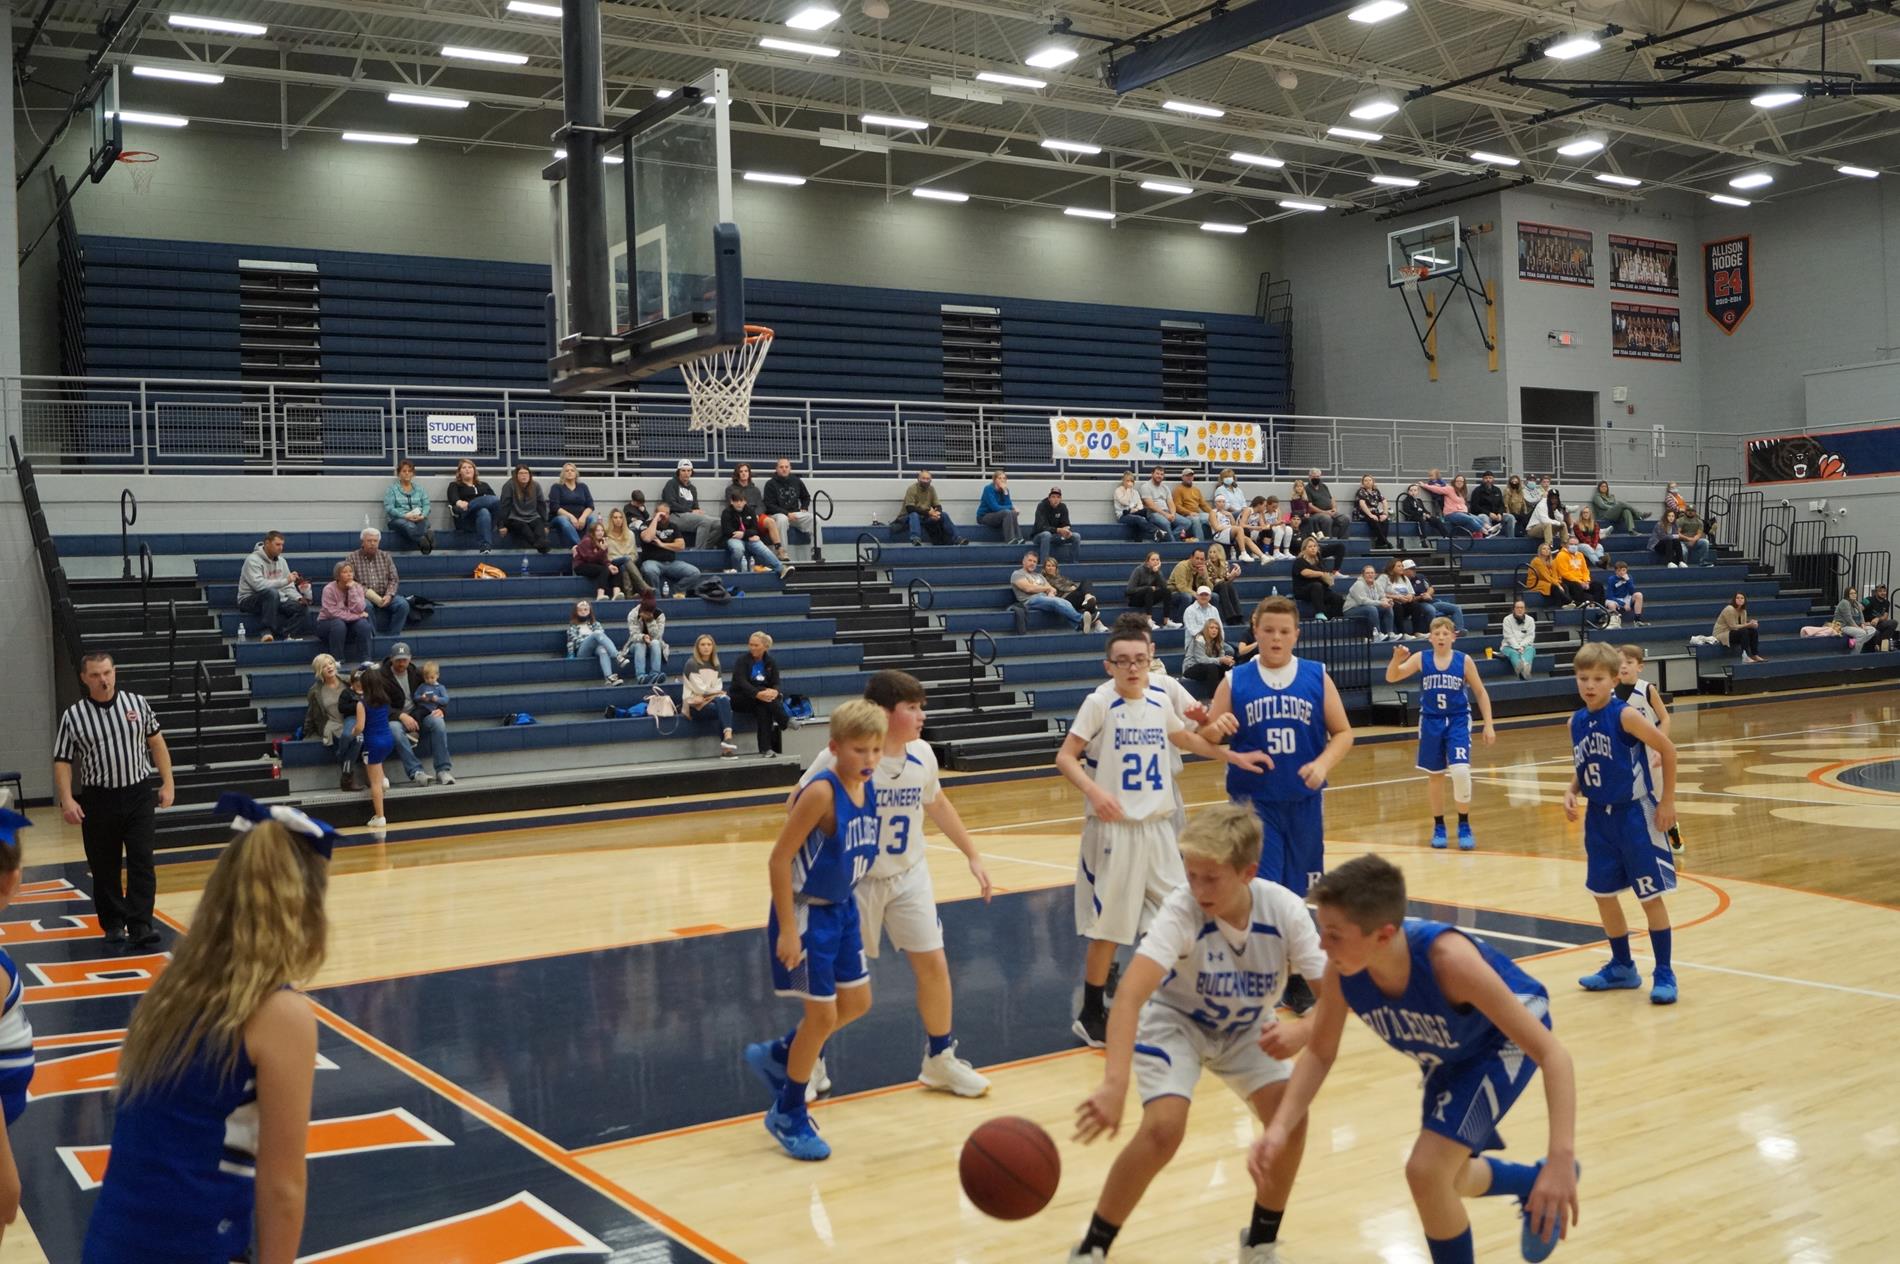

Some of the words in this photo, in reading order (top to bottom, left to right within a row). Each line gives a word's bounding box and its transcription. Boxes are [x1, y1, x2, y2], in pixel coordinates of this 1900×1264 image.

[1712, 241, 1743, 257] ALLISON
[1712, 253, 1743, 271] HODGE
[1714, 269, 1742, 298] 24
[429, 422, 475, 432] STUDENT
[431, 435, 474, 444] SECTION
[1087, 432, 1113, 450] GO
[1422, 673, 1464, 690] RUTLEDGE
[1245, 695, 1313, 726] RUTLEDGE
[1437, 693, 1448, 710] 5
[1115, 728, 1165, 750] BUCCANEERS
[1266, 727, 1296, 754] 50
[1454, 746, 1468, 760] R
[1122, 753, 1163, 791] 24
[1584, 763, 1602, 787] 15
[876, 787, 921, 810] CCANEERS
[1636, 876, 1658, 896] R
[1196, 971, 1278, 997] BUCCANEERS
